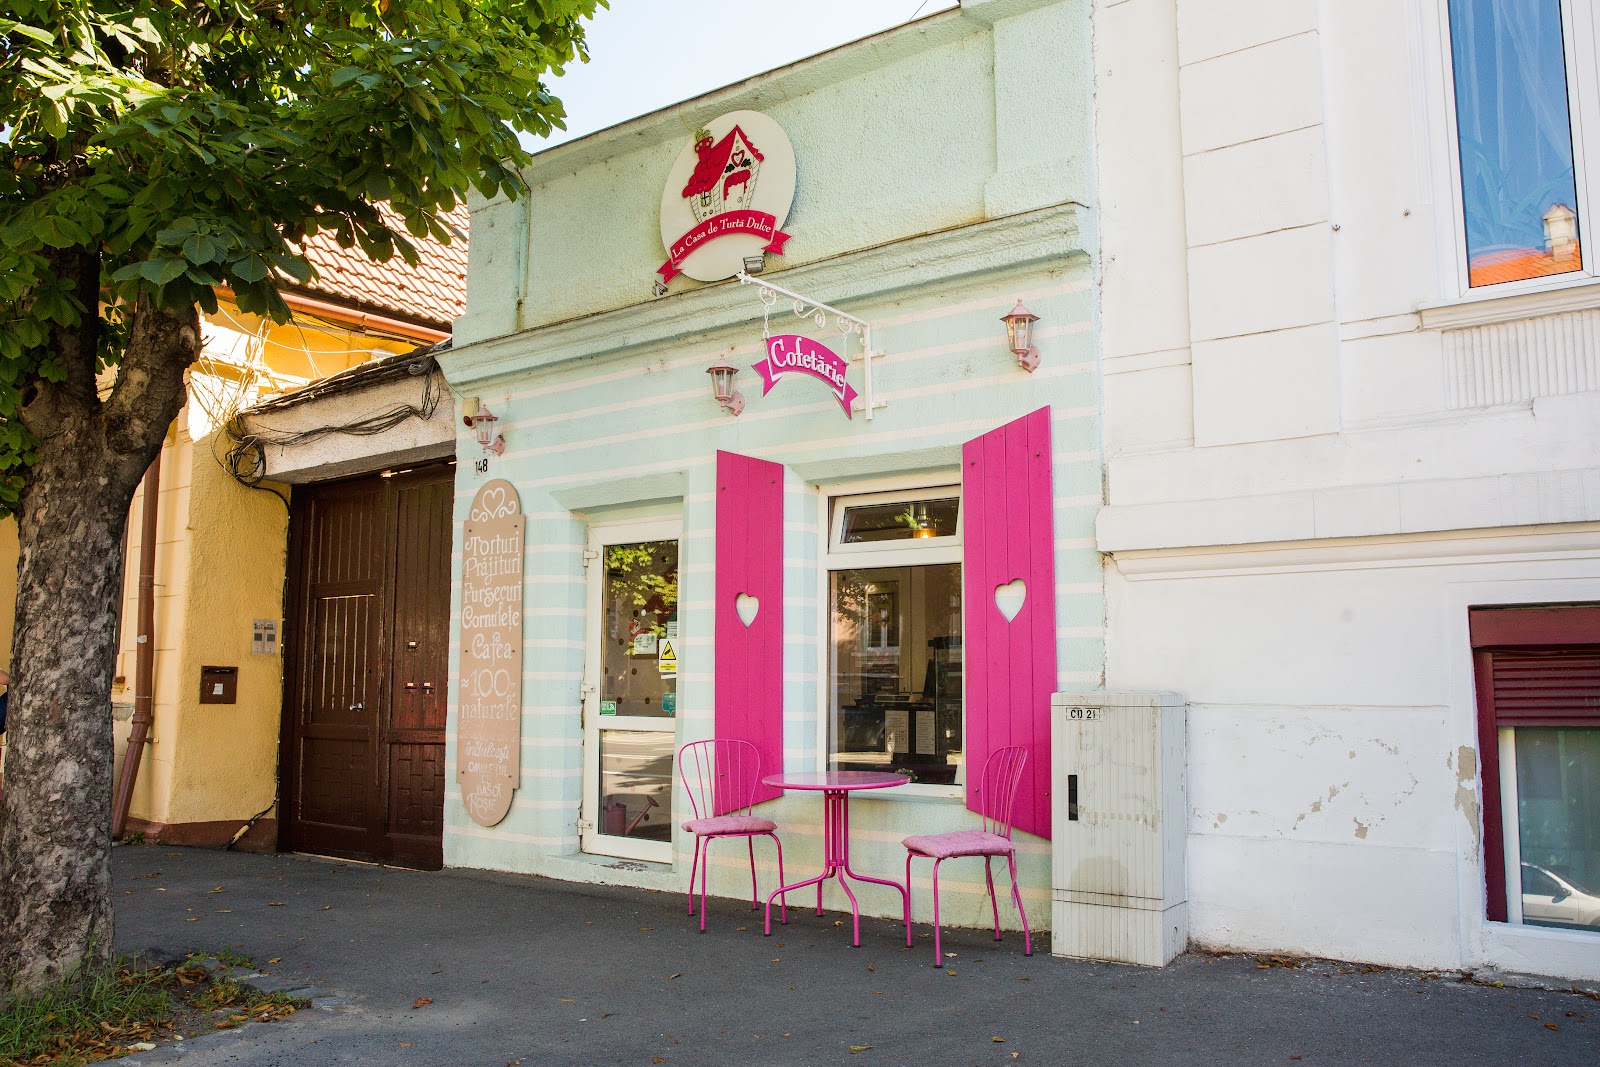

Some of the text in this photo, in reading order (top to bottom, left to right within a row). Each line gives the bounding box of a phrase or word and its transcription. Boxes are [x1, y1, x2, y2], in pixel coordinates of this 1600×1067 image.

[672, 246, 685, 258] La
[685, 231, 707, 247] Casa
[707, 221, 718, 234] de
[745, 216, 772, 233] Dulce
[770, 336, 845, 388] Cofetărie
[475, 458, 488, 474] 148
[464, 530, 520, 557] Torturi
[463, 552, 521, 586] Prăjituri
[463, 580, 522, 608] Fursecuri
[461, 601, 520, 633] Cornulețe
[471, 631, 513, 667] Cafea
[461, 693, 518, 721] naturale
[1070, 709, 1096, 719] CD 21
